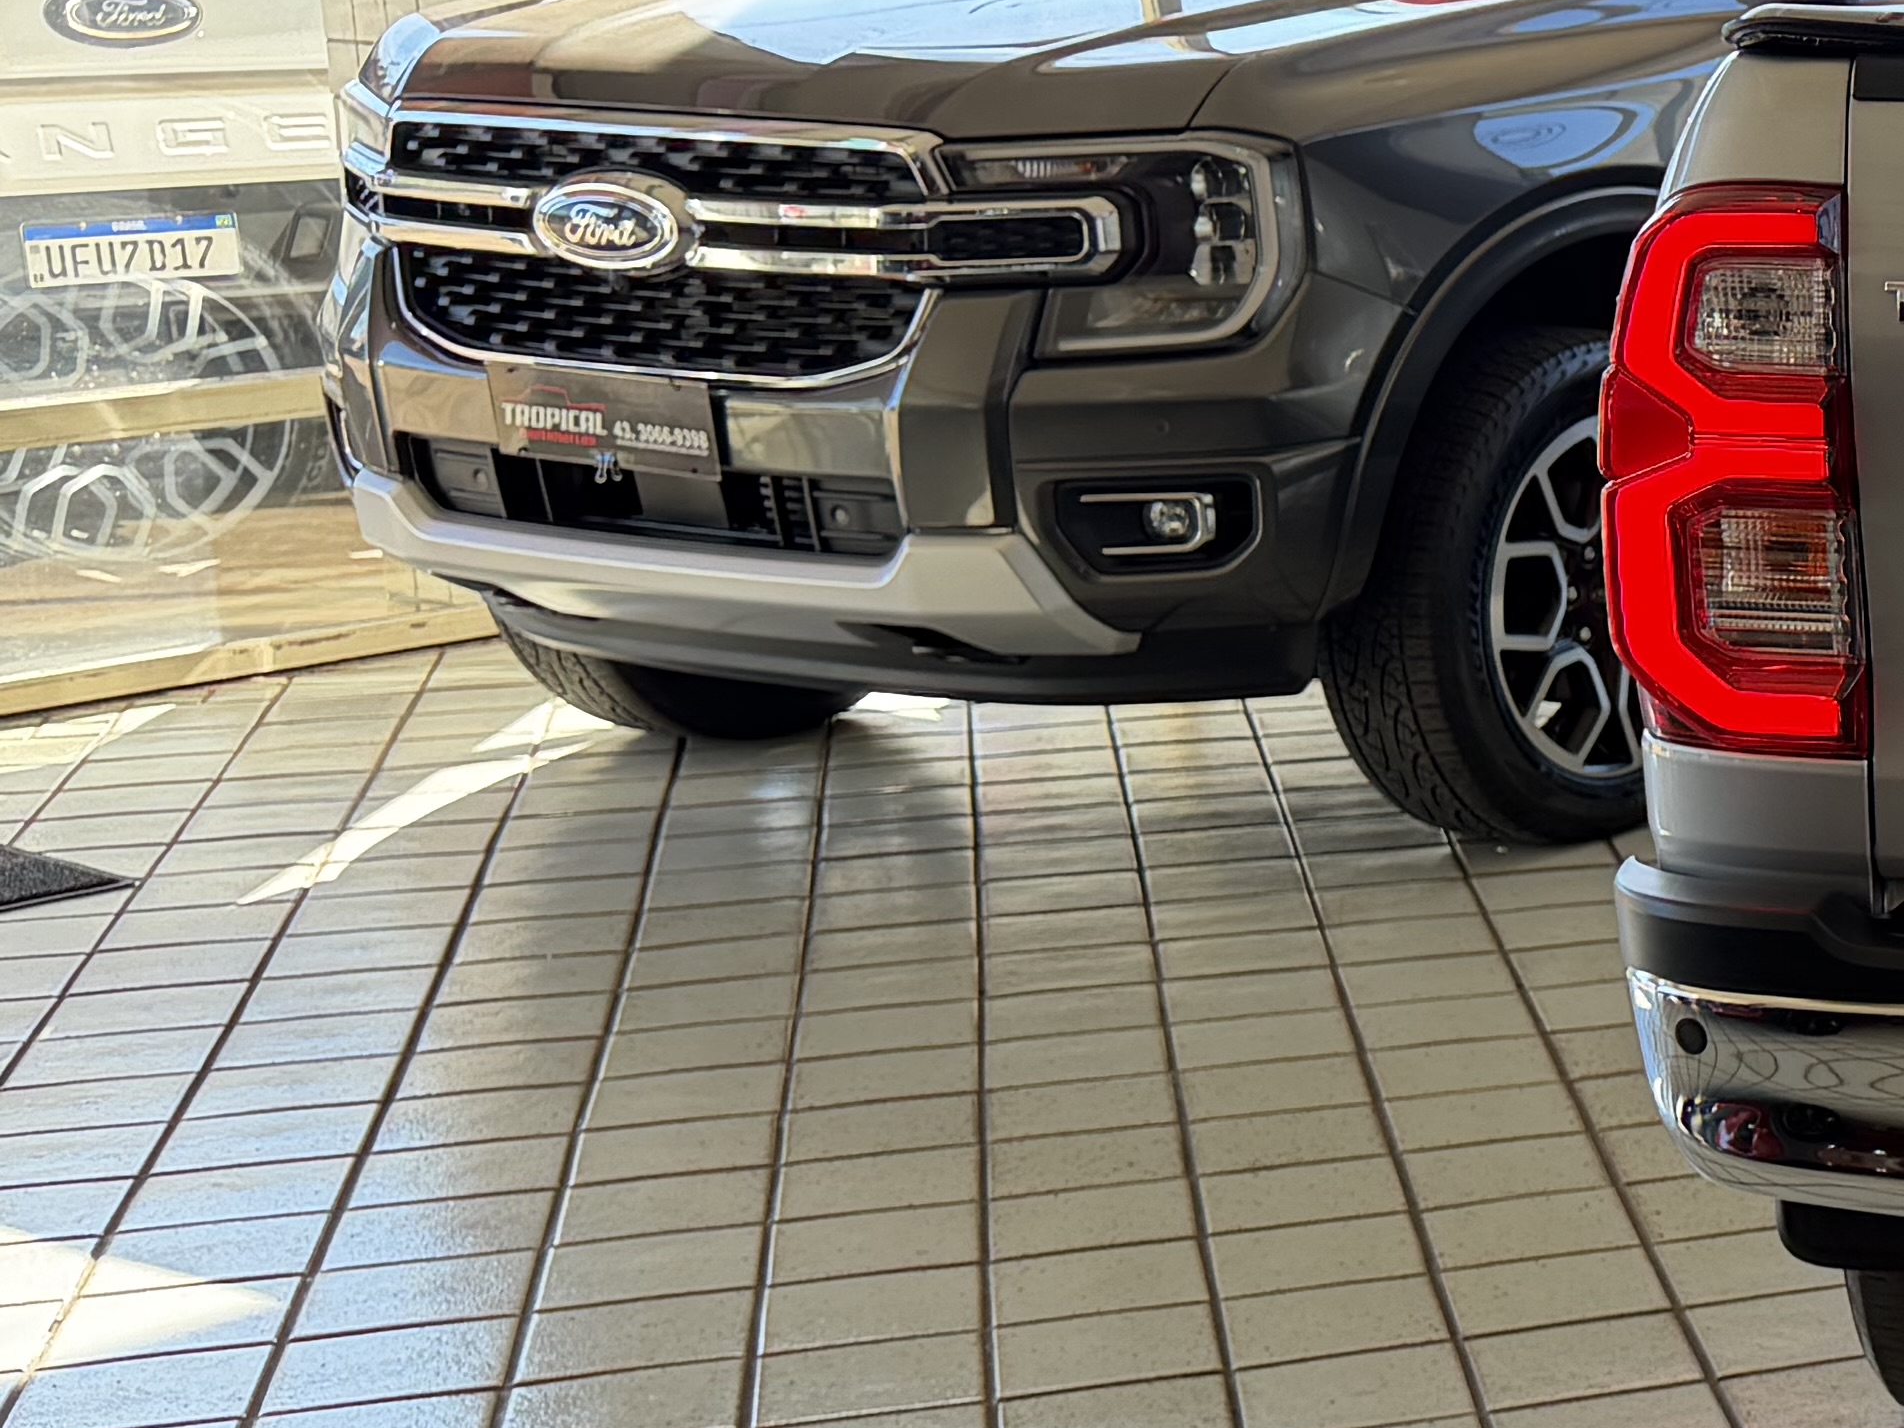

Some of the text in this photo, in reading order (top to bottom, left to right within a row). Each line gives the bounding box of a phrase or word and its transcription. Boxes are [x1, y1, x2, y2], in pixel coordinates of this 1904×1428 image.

[0, 112, 332, 164] NGE
[564, 203, 637, 246] Ford
[501, 401, 608, 437] TROPICAL
